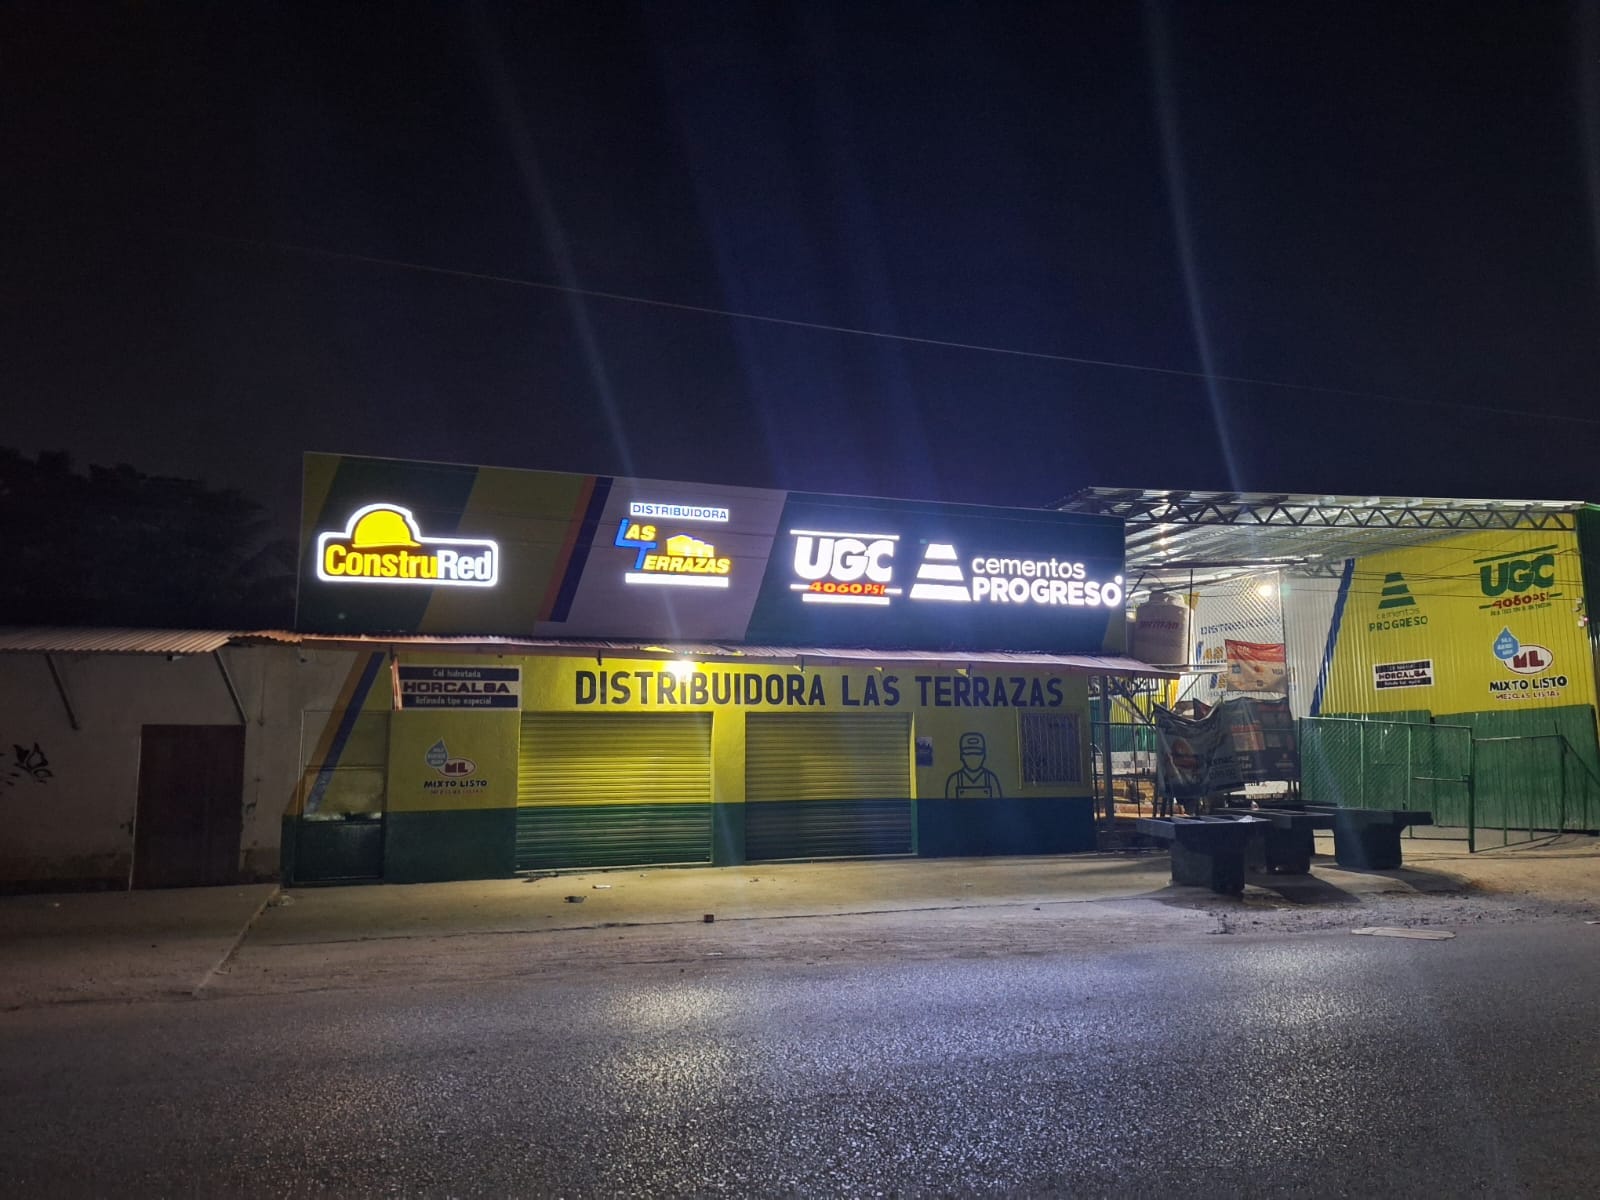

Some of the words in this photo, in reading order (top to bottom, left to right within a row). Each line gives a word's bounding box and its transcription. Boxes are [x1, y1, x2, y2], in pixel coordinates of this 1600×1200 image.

[632, 504, 727, 519] DISTRIBUIDORA
[614, 518, 657, 548] LAS
[325, 544, 492, 580] ConstruRed
[634, 541, 731, 574] TERRAZAS
[794, 536, 895, 582] UGC
[972, 557, 1086, 579] cementos
[808, 581, 863, 594] 4060
[863, 583, 886, 595] PSI
[1480, 554, 1555, 597] UGC
[972, 576, 1122, 607] PROGRESO
[1369, 616, 1428, 632] PROGRESO
[575, 670, 826, 706] DISTRIBUIDORA
[842, 674, 899, 707] LAS
[915, 675, 1064, 708] TERRAZAS
[1489, 680, 1528, 692] MIXTO
[1532, 676, 1567, 689] LISTO
